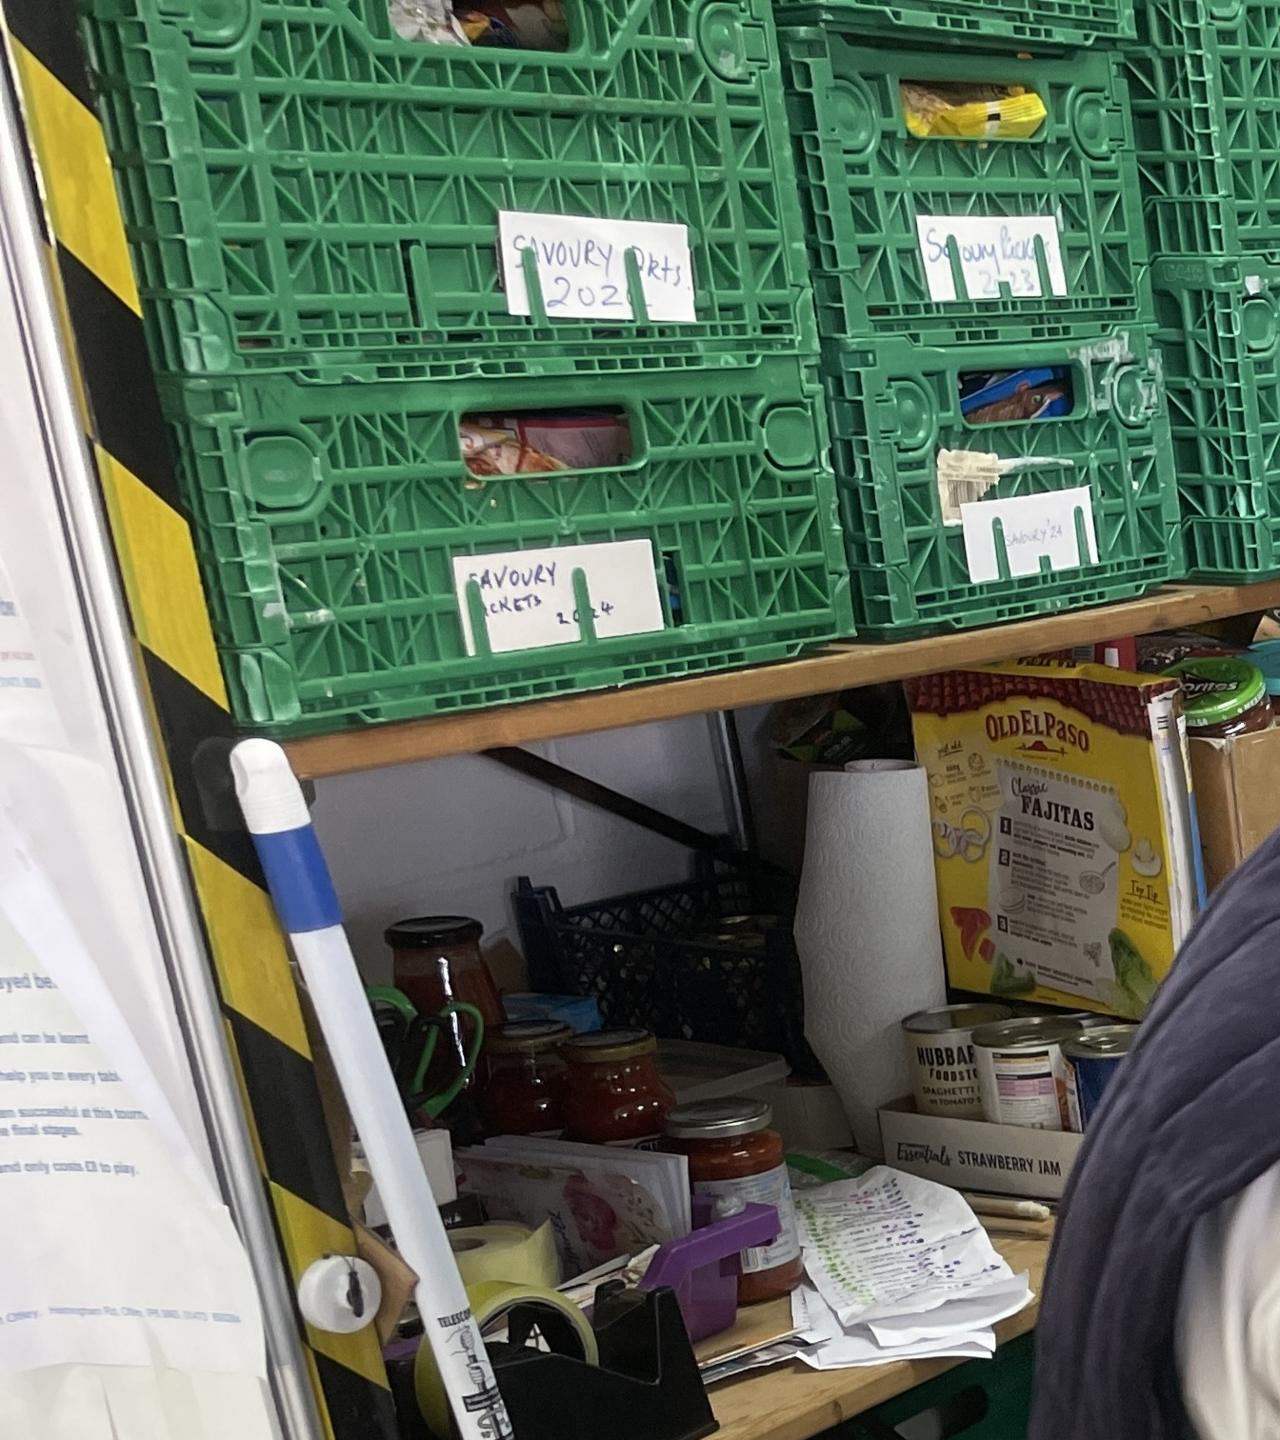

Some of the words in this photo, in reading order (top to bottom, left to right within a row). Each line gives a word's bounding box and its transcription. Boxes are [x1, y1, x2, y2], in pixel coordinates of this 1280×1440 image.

[546, 276, 653, 309] 202
[978, 268, 1035, 295] 223
[469, 561, 558, 593] AVOURY
[1020, 794, 1095, 832] FAJITAS
[896, 1142, 952, 1168] Essentials
[957, 1149, 1035, 1173] STRAWBERRY
[1037, 1159, 1062, 1177] JAM
